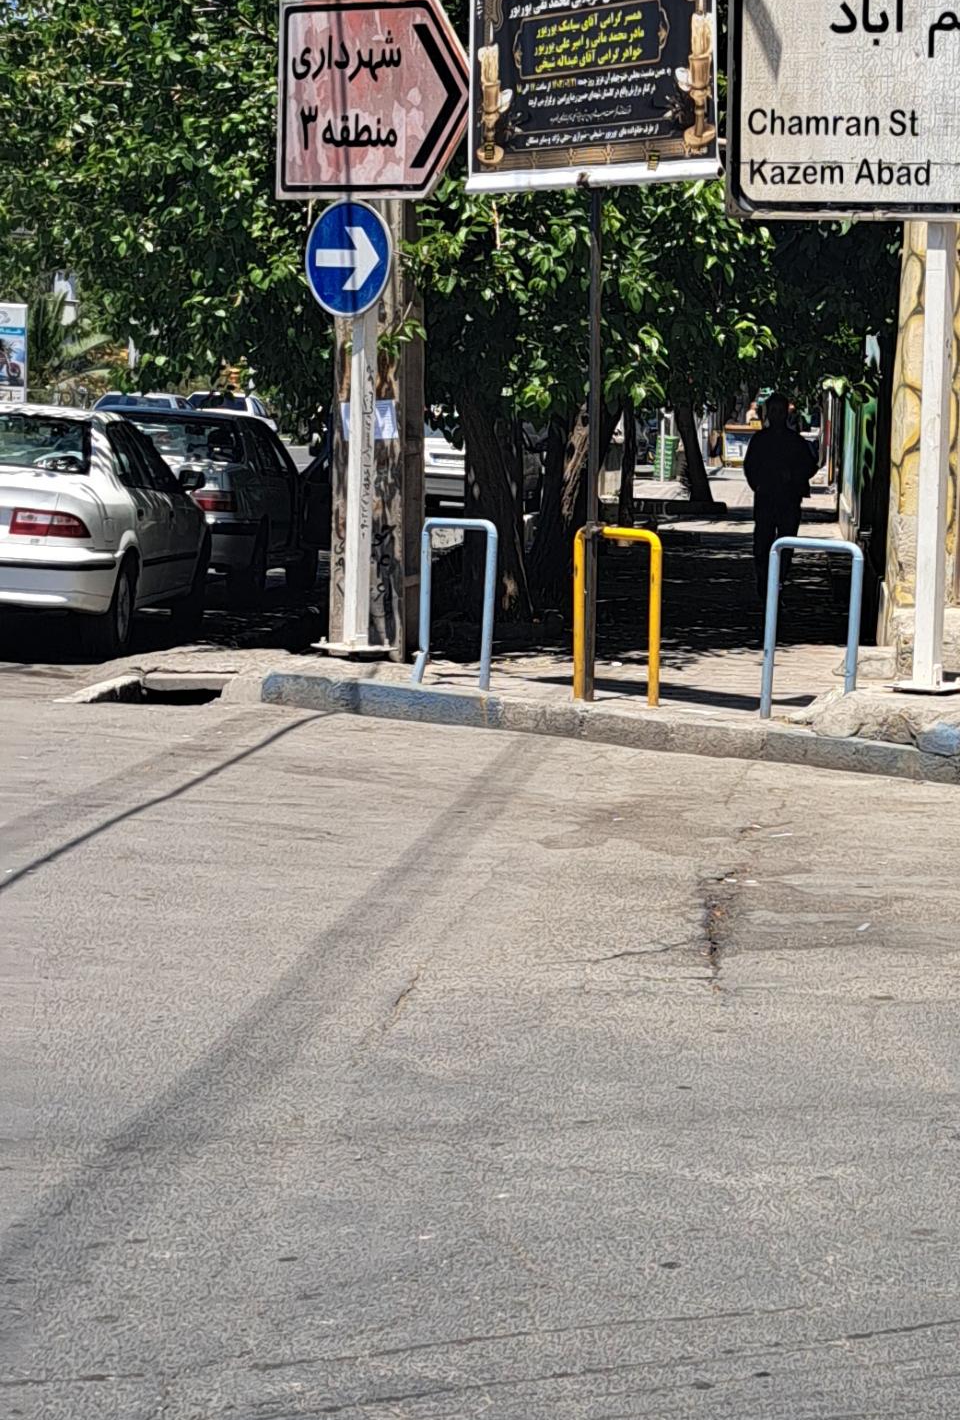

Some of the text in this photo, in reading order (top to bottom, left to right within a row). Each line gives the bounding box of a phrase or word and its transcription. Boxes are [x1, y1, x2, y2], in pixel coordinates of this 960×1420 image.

[291, 29, 401, 82] شهرداری
[300, 104, 398, 150] منطقه ۳
[747, 108, 920, 137] Chamran St
[748, 159, 931, 186] Kazem Abad
